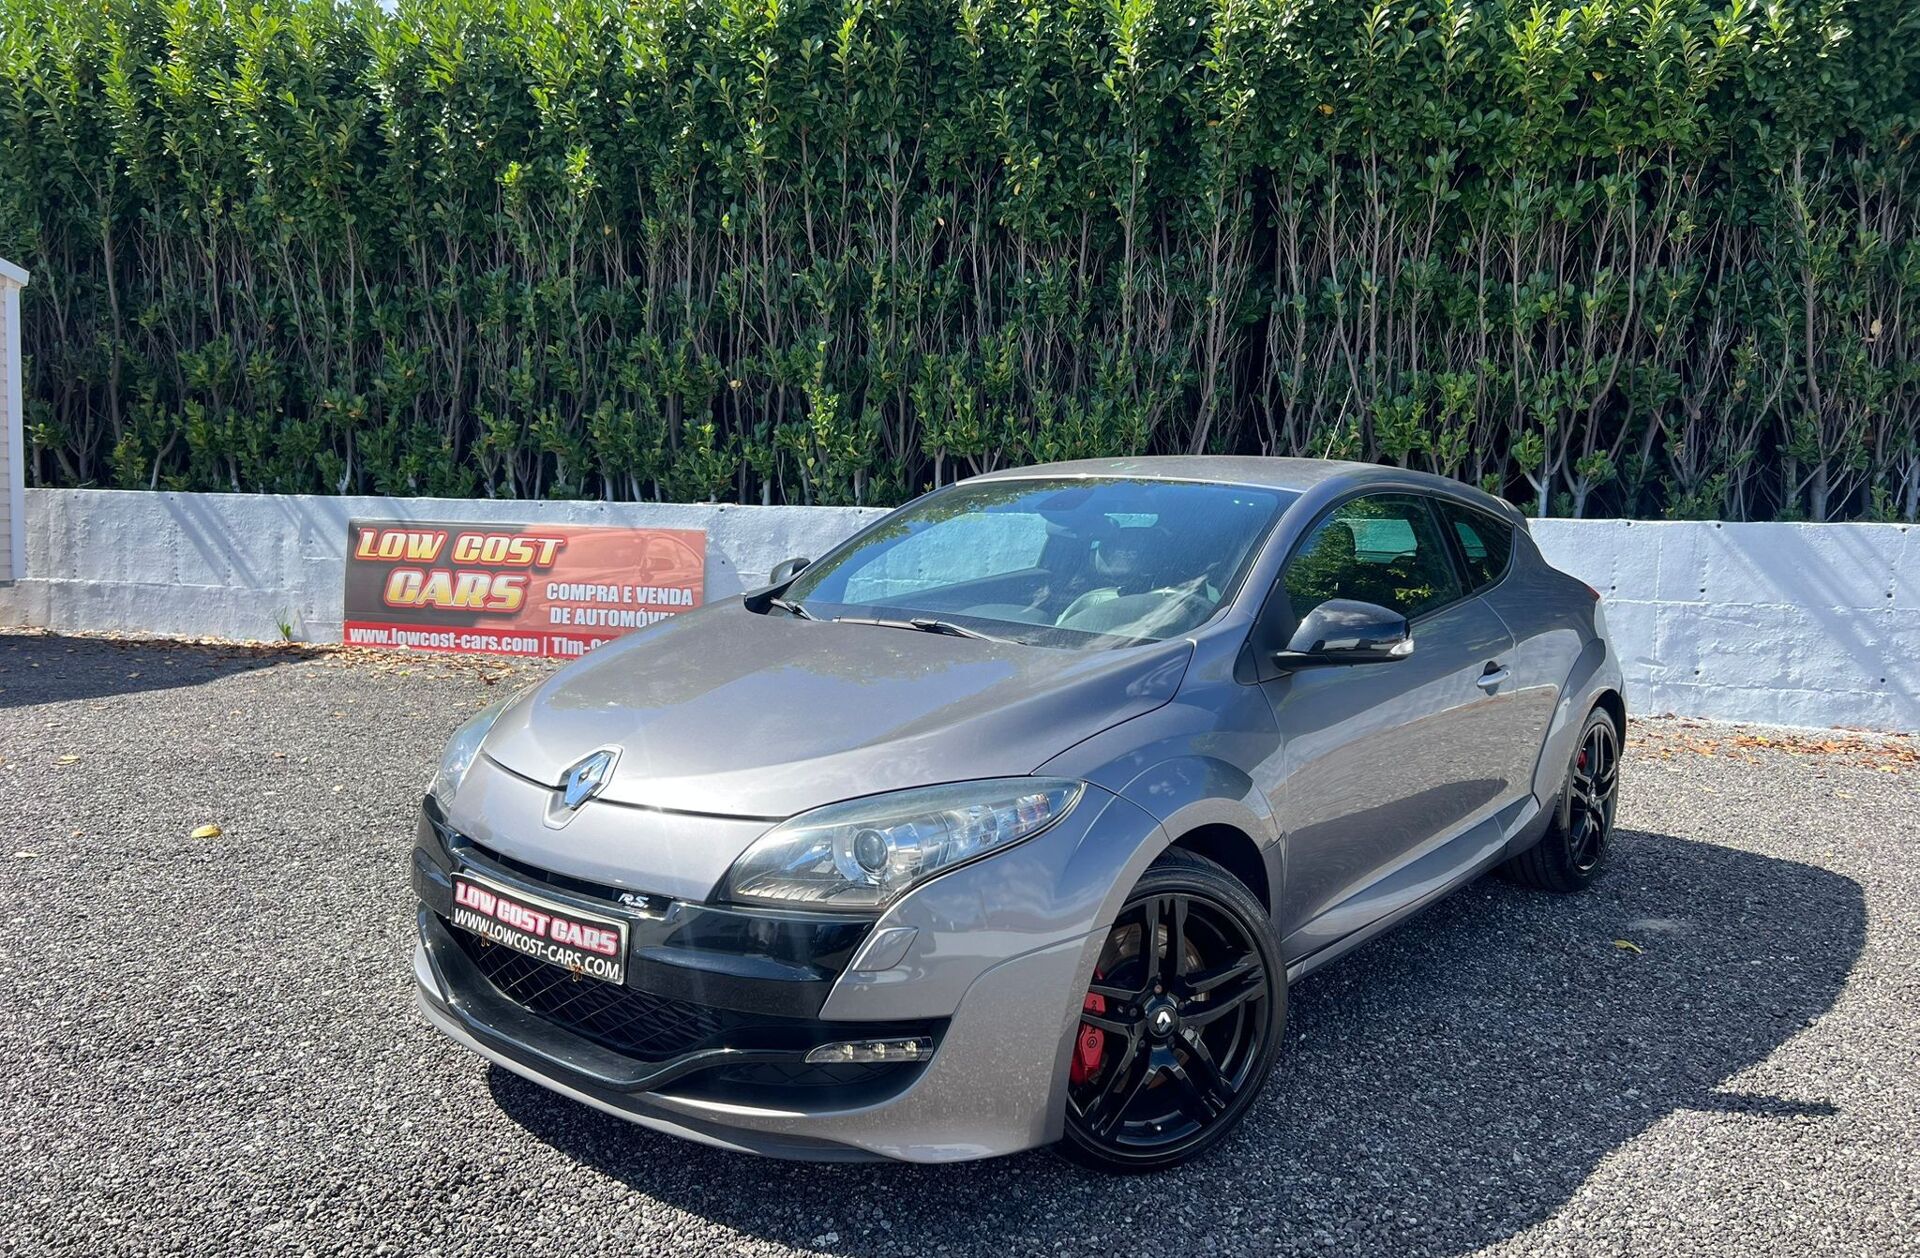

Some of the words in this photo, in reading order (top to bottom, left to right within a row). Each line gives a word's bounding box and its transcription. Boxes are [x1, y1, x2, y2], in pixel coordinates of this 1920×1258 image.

[356, 530, 446, 558] LOW
[453, 534, 564, 565] COST
[387, 569, 526, 610] CARS
[546, 582, 619, 603] COMPRA
[623, 586, 633, 603] E
[636, 586, 694, 606] VENDA
[550, 607, 571, 624] DE
[574, 607, 676, 628] AUTOMÓV
[350, 627, 538, 652] www.lowcost-cars.com
[455, 882, 497, 916] LOW
[496, 898, 551, 937] COST
[550, 918, 618, 956] CARS
[454, 908, 620, 980] WWW.LOWCOST-CARS.COM
